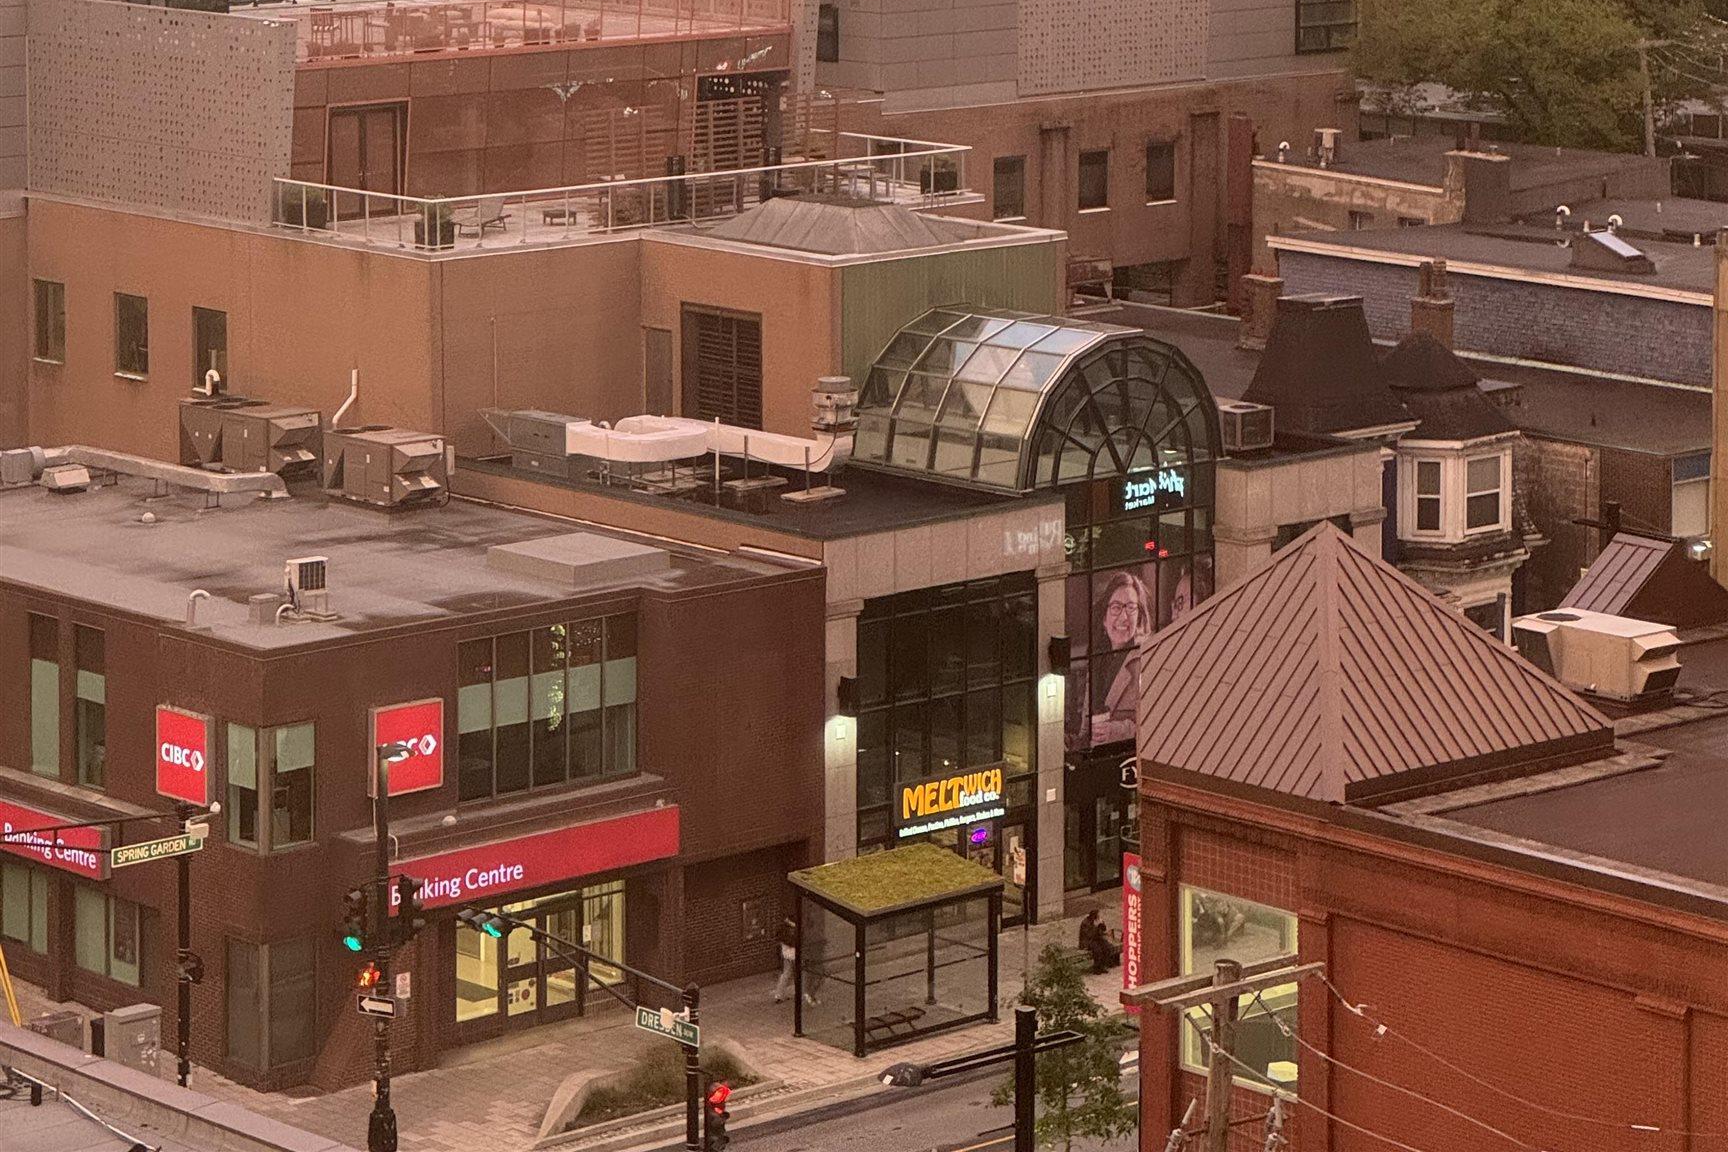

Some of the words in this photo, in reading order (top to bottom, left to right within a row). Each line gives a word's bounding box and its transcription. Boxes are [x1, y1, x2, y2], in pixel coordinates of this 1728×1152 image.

[161, 742, 191, 767] CIBC
[960, 790, 983, 807] food
[55, 838, 97, 869] Centre
[116, 845, 149, 864] SPRING
[150, 839, 187, 856] GARDEN
[391, 877, 462, 907] Bnking
[465, 863, 524, 890] Centre
[1127, 893, 1138, 989] HOPPERS
[641, 1011, 683, 1037] DREEN
